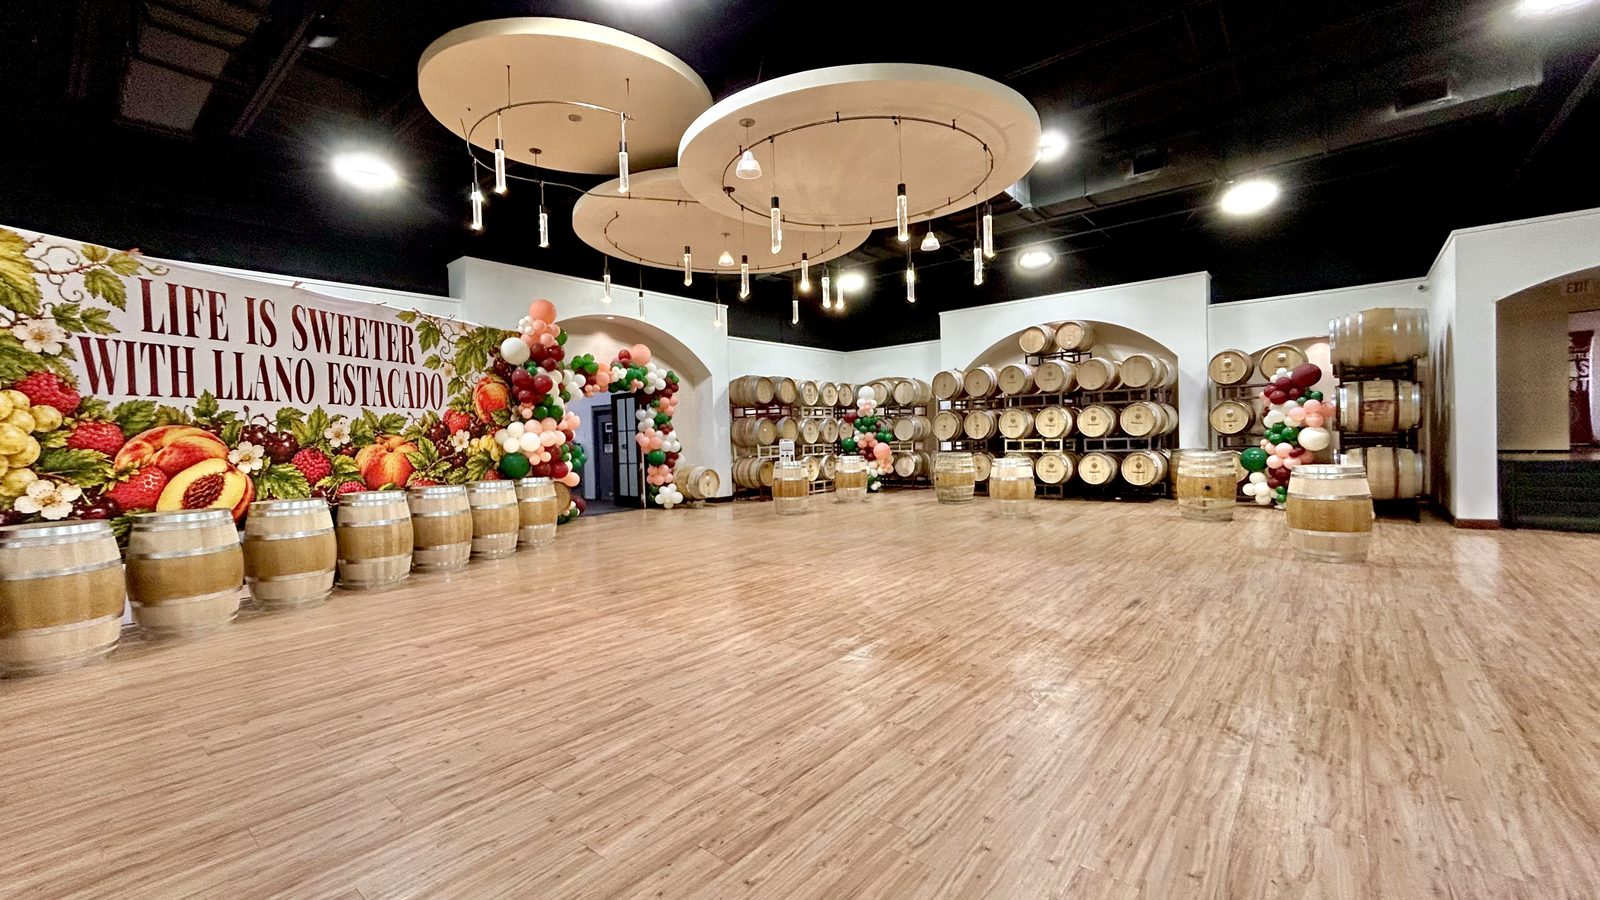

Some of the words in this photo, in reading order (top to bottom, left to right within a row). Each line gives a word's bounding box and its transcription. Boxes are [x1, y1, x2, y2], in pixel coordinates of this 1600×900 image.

[138, 278, 230, 342] LIFE
[245, 296, 277, 348] IS
[291, 304, 416, 366] SWEETER
[1566, 281, 1590, 294] EXIT
[77, 335, 198, 399] WITH
[211, 349, 315, 404] LLANO
[327, 362, 444, 411] ESTACADO
